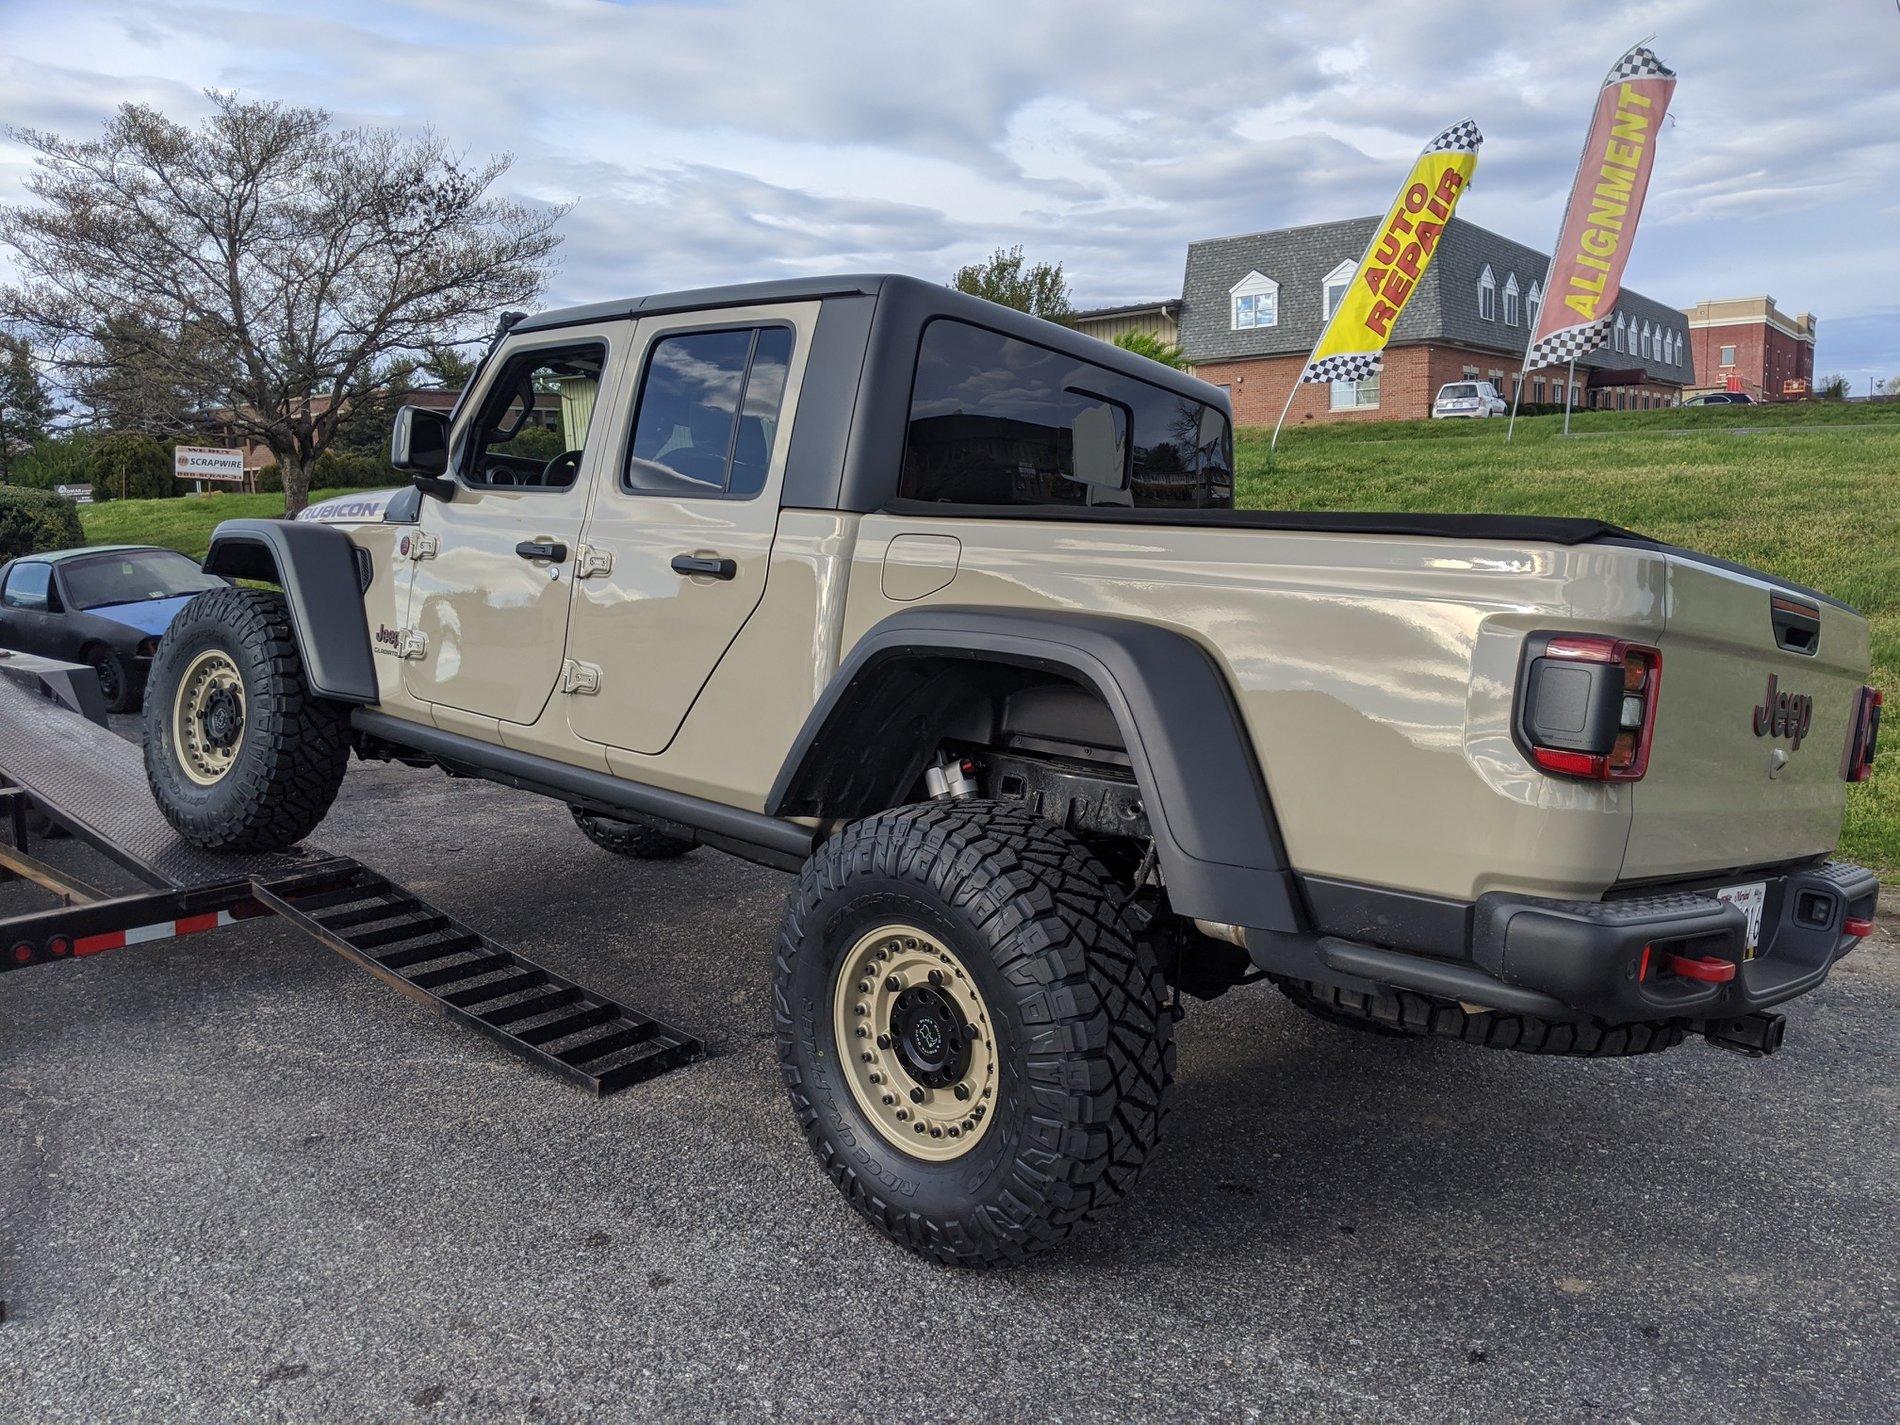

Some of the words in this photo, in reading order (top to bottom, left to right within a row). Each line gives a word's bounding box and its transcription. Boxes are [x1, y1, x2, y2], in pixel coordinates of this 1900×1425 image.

[1364, 182, 1429, 297] AUTO
[1563, 82, 1654, 321] ALIGNMENT
[1365, 167, 1463, 338] REPAIR
[189, 457, 242, 468] SCRAPWIRE
[300, 502, 380, 520] RUBICON
[375, 623, 400, 650] Jeep
[1753, 672, 1813, 752] Jeep
[801, 996, 858, 1147] GRAPPLER
[852, 1146, 921, 1198] RIDGE
